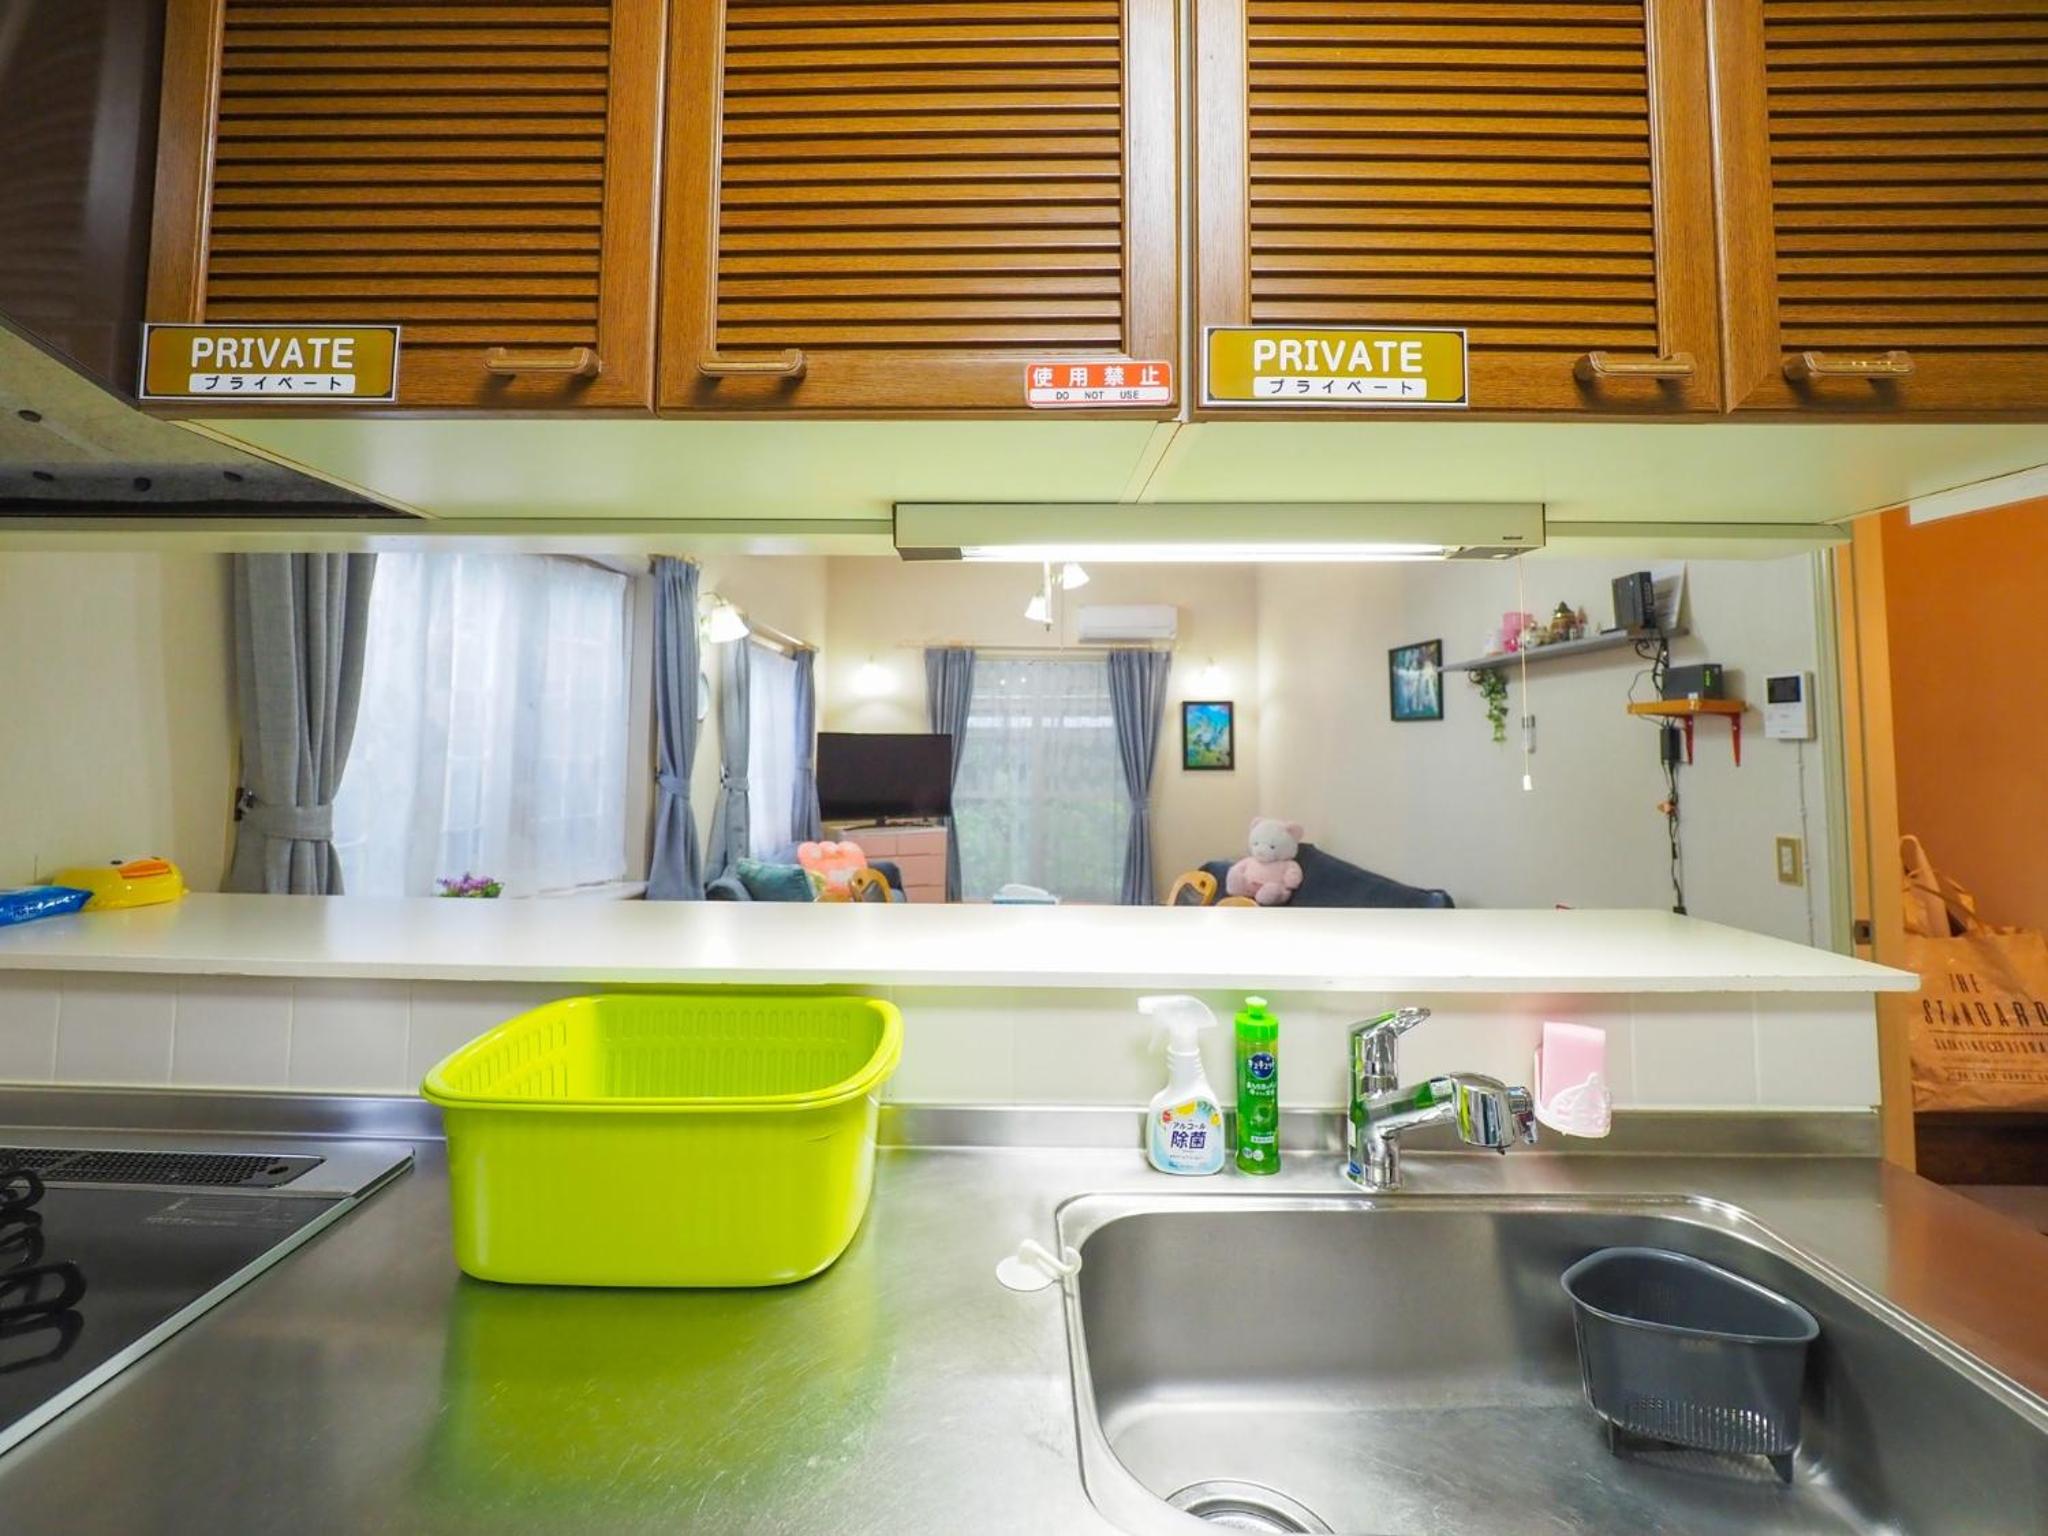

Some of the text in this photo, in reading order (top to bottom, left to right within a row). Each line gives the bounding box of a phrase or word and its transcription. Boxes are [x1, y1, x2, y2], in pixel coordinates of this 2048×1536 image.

[191, 337, 355, 368] PRIVATE
[1253, 340, 1423, 372] PRIVATE
[204, 376, 342, 390] プライベート
[1033, 366, 1160, 387] 使用禁止
[1056, 390, 1139, 400] DO NOT USE
[1270, 380, 1413, 394] プライベート
[1171, 1131, 1207, 1149] 除菌
